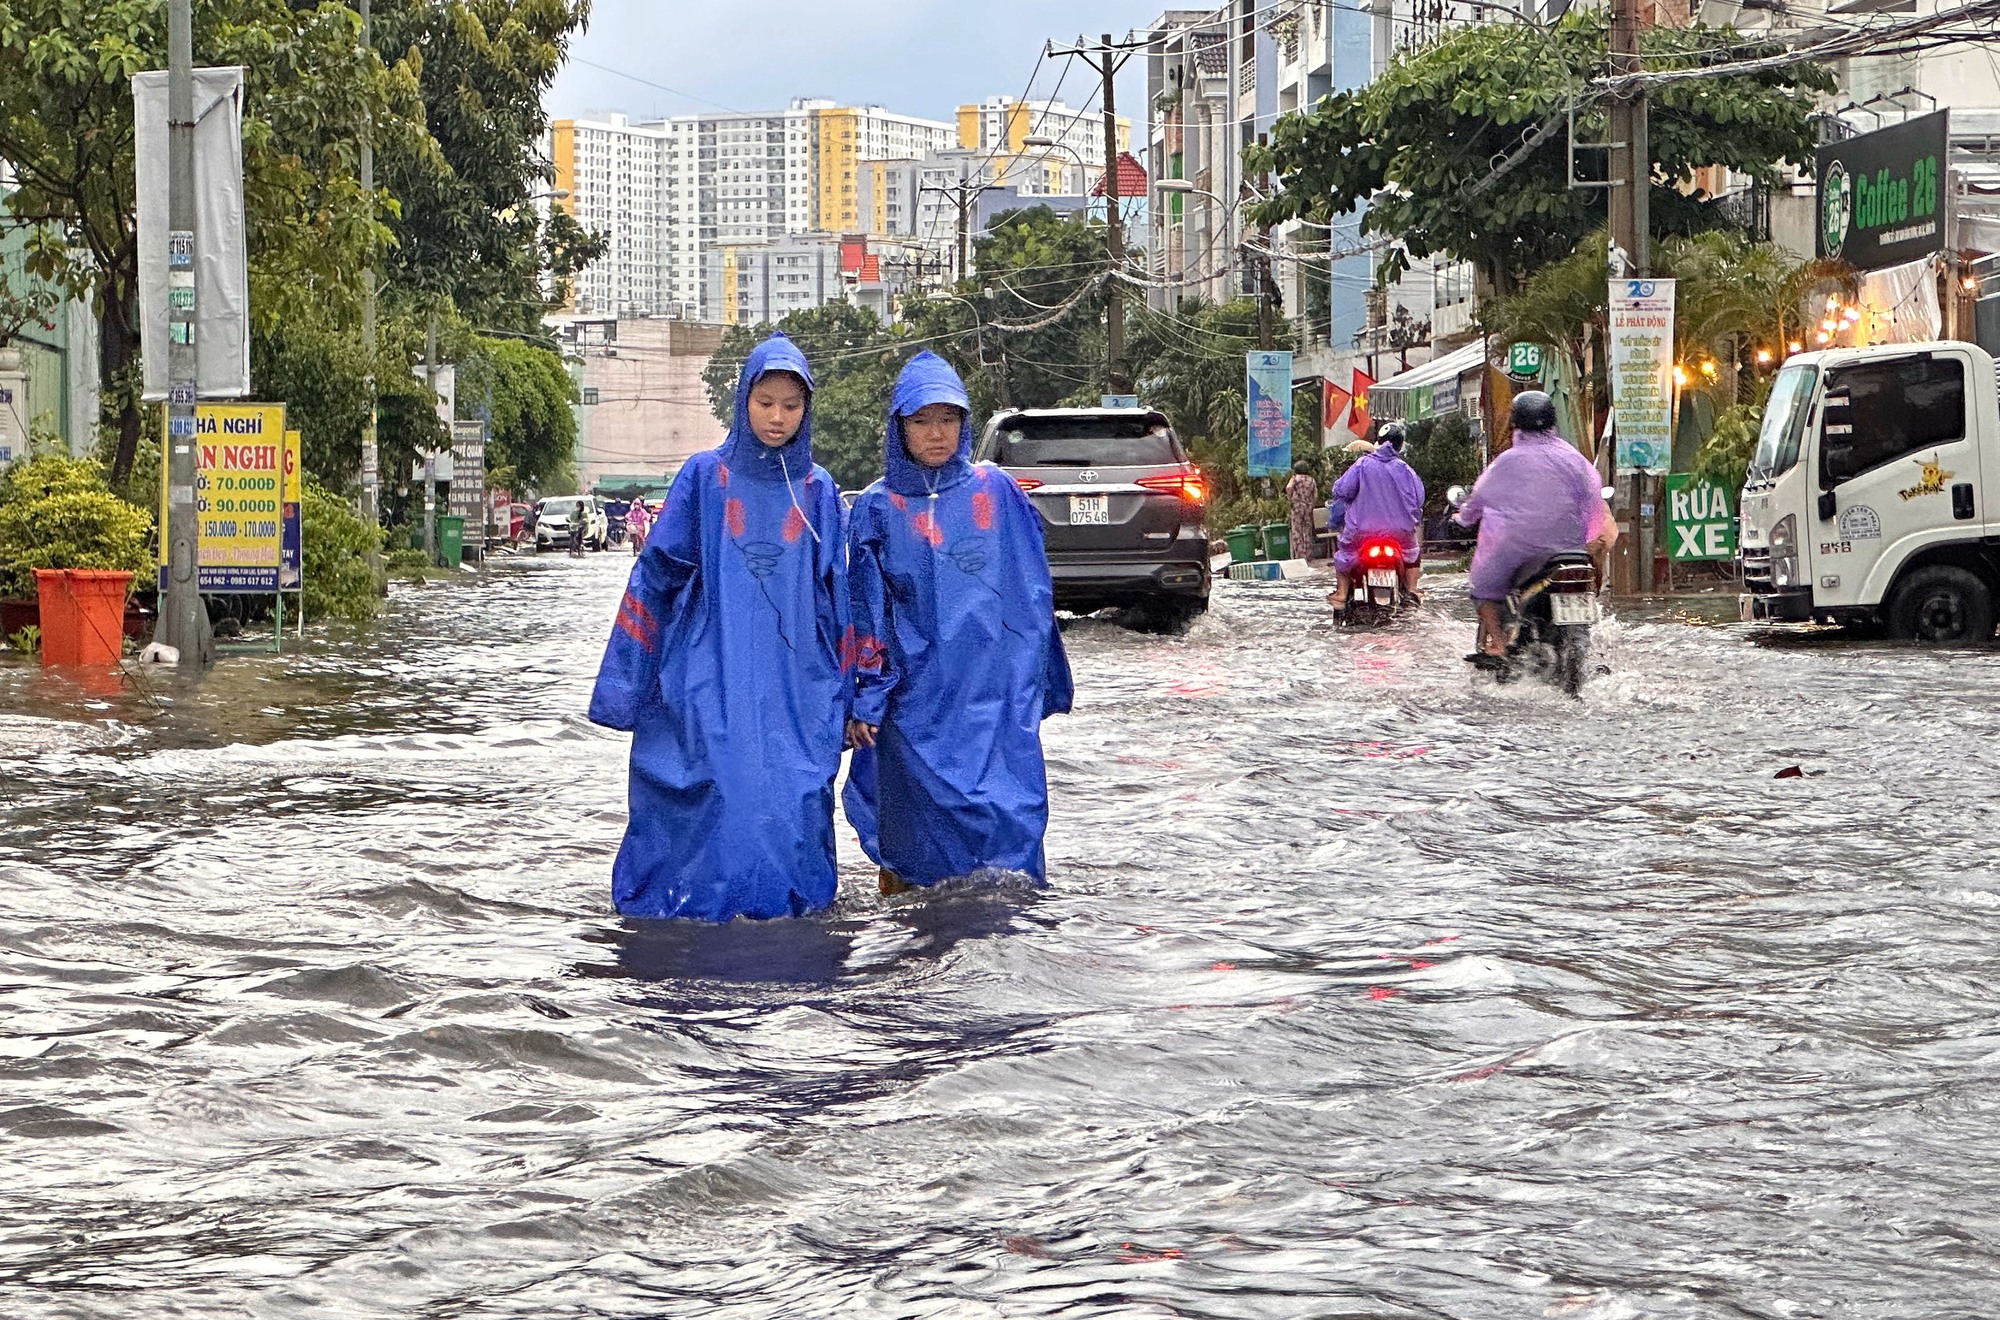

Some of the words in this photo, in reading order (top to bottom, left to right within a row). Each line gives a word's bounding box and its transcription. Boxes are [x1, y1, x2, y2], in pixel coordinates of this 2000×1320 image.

[1856, 167, 1908, 230] Coffee
[1913, 155, 1936, 217] 26
[1829, 201, 1840, 233] 26
[1627, 315, 1645, 328] PHÁT
[1647, 315, 1666, 329] ĐỘNG
[1514, 346, 1539, 366] 26
[197, 413, 217, 433] HÀ
[223, 412, 263, 434] NGHỈ
[223, 445, 276, 470] NGHI
[216, 477, 275, 490] 70.000Đ
[217, 499, 276, 512] 90.000Đ
[1079, 499, 1100, 511] 51H
[1671, 477, 1729, 521] RỬA
[1071, 511, 1107, 524] 075.48
[204, 520, 237, 537] 150.000Đ
[244, 520, 276, 537] 170.000Đ
[1675, 523, 1730, 557] XE
[247, 576, 259, 586] 617
[261, 576, 273, 586] 612
